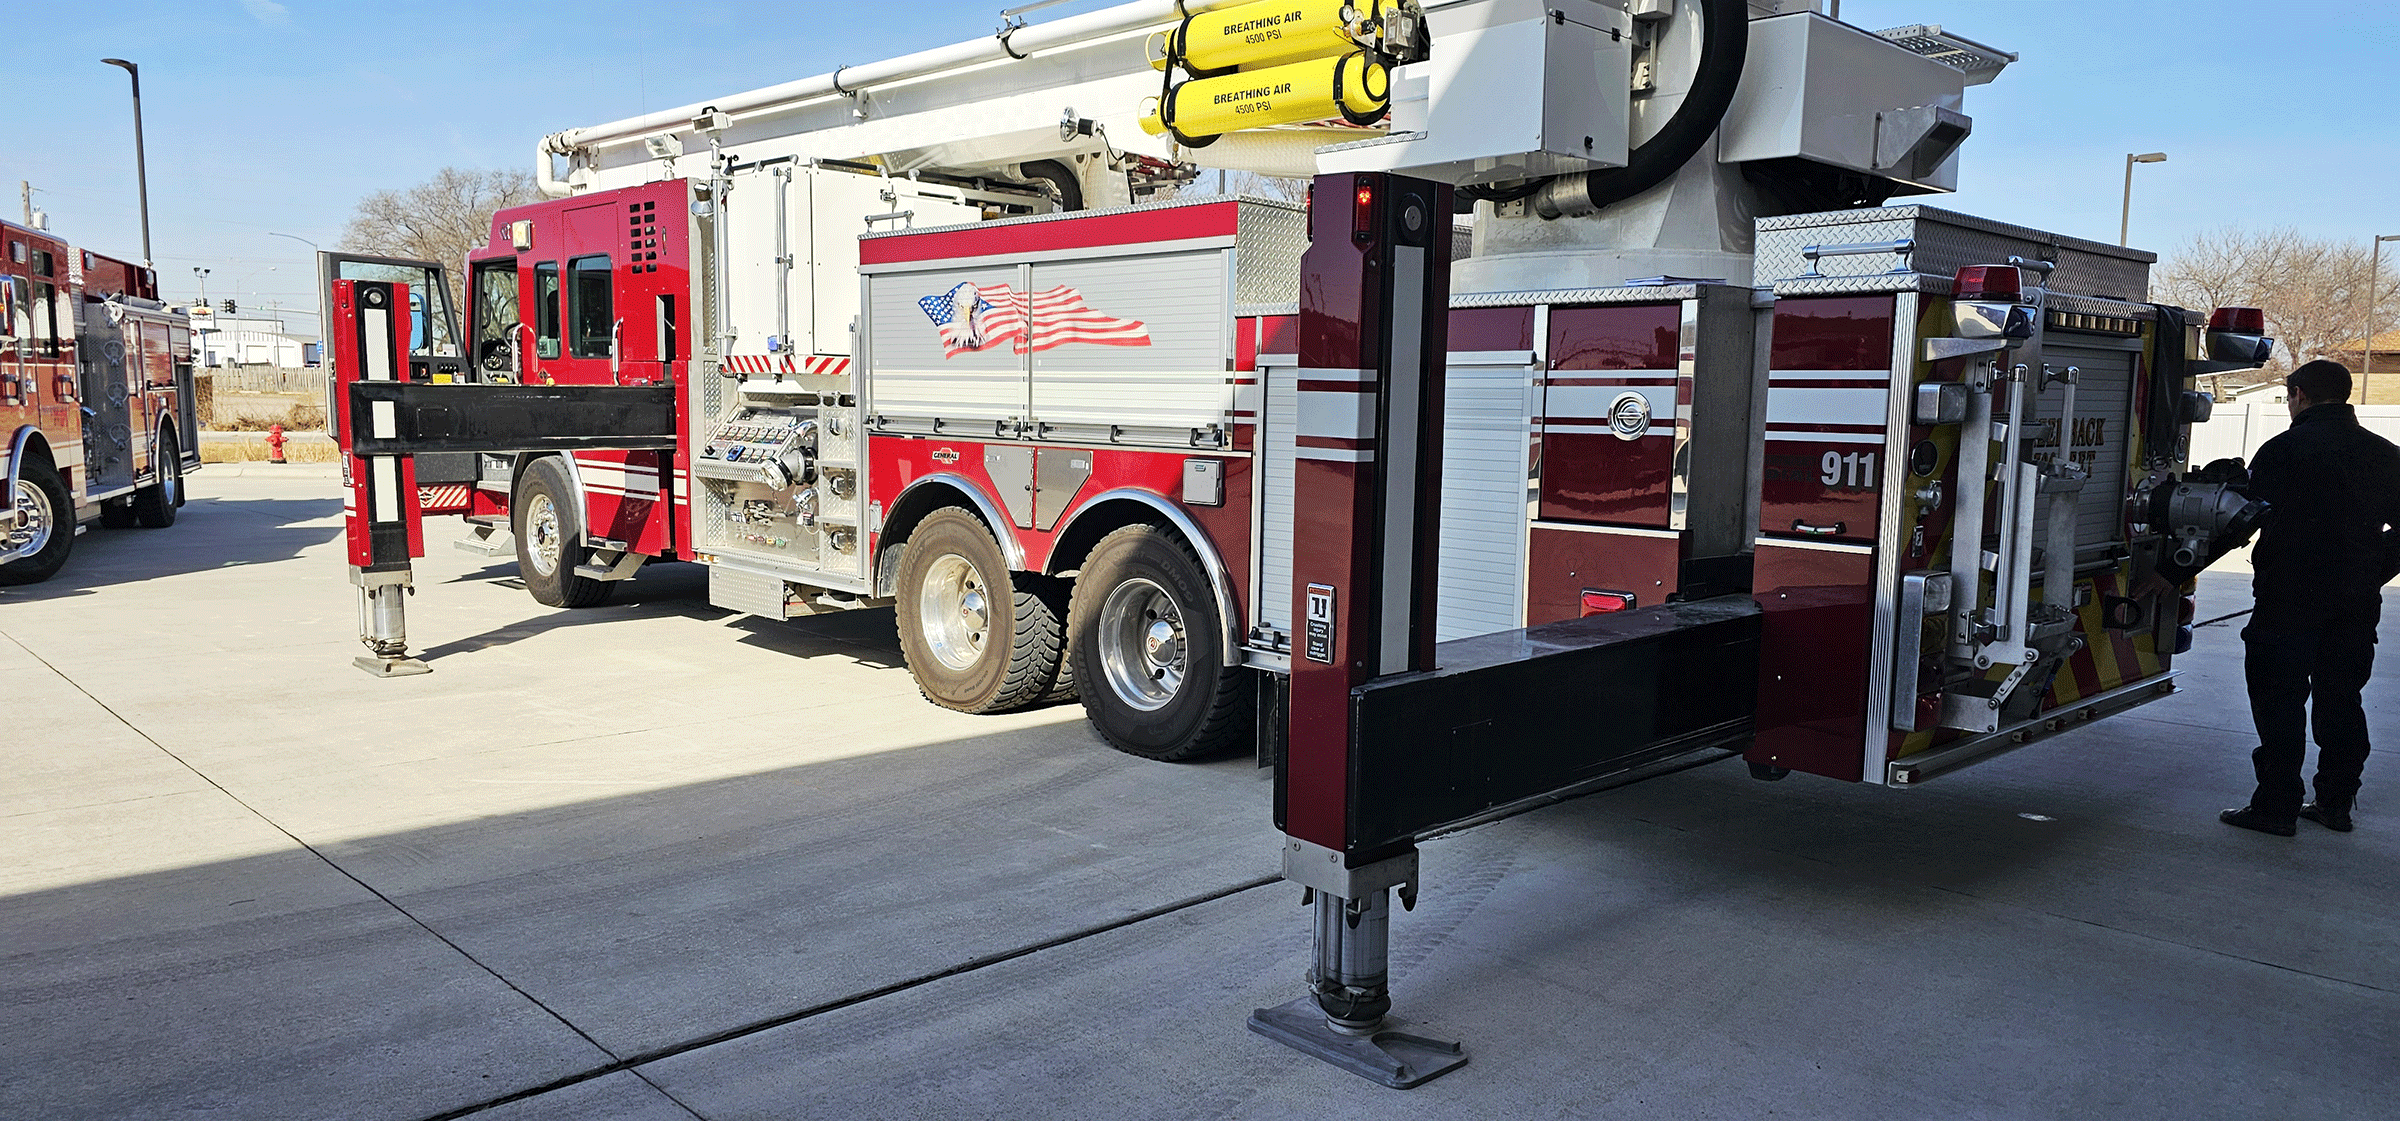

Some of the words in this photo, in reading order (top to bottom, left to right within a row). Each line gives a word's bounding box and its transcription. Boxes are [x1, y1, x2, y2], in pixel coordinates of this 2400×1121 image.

[1224, 15, 1281, 36] BREATHING
[1284, 11, 1302, 23] AIR
[1245, 33, 1265, 44] 4500
[1267, 29, 1281, 40] PSI
[1214, 86, 1271, 105] BREATHING
[1273, 83, 1291, 95] AIR
[1235, 104, 1255, 114] 4500
[1256, 101, 1272, 111] PSI
[1821, 451, 1875, 488] 911
